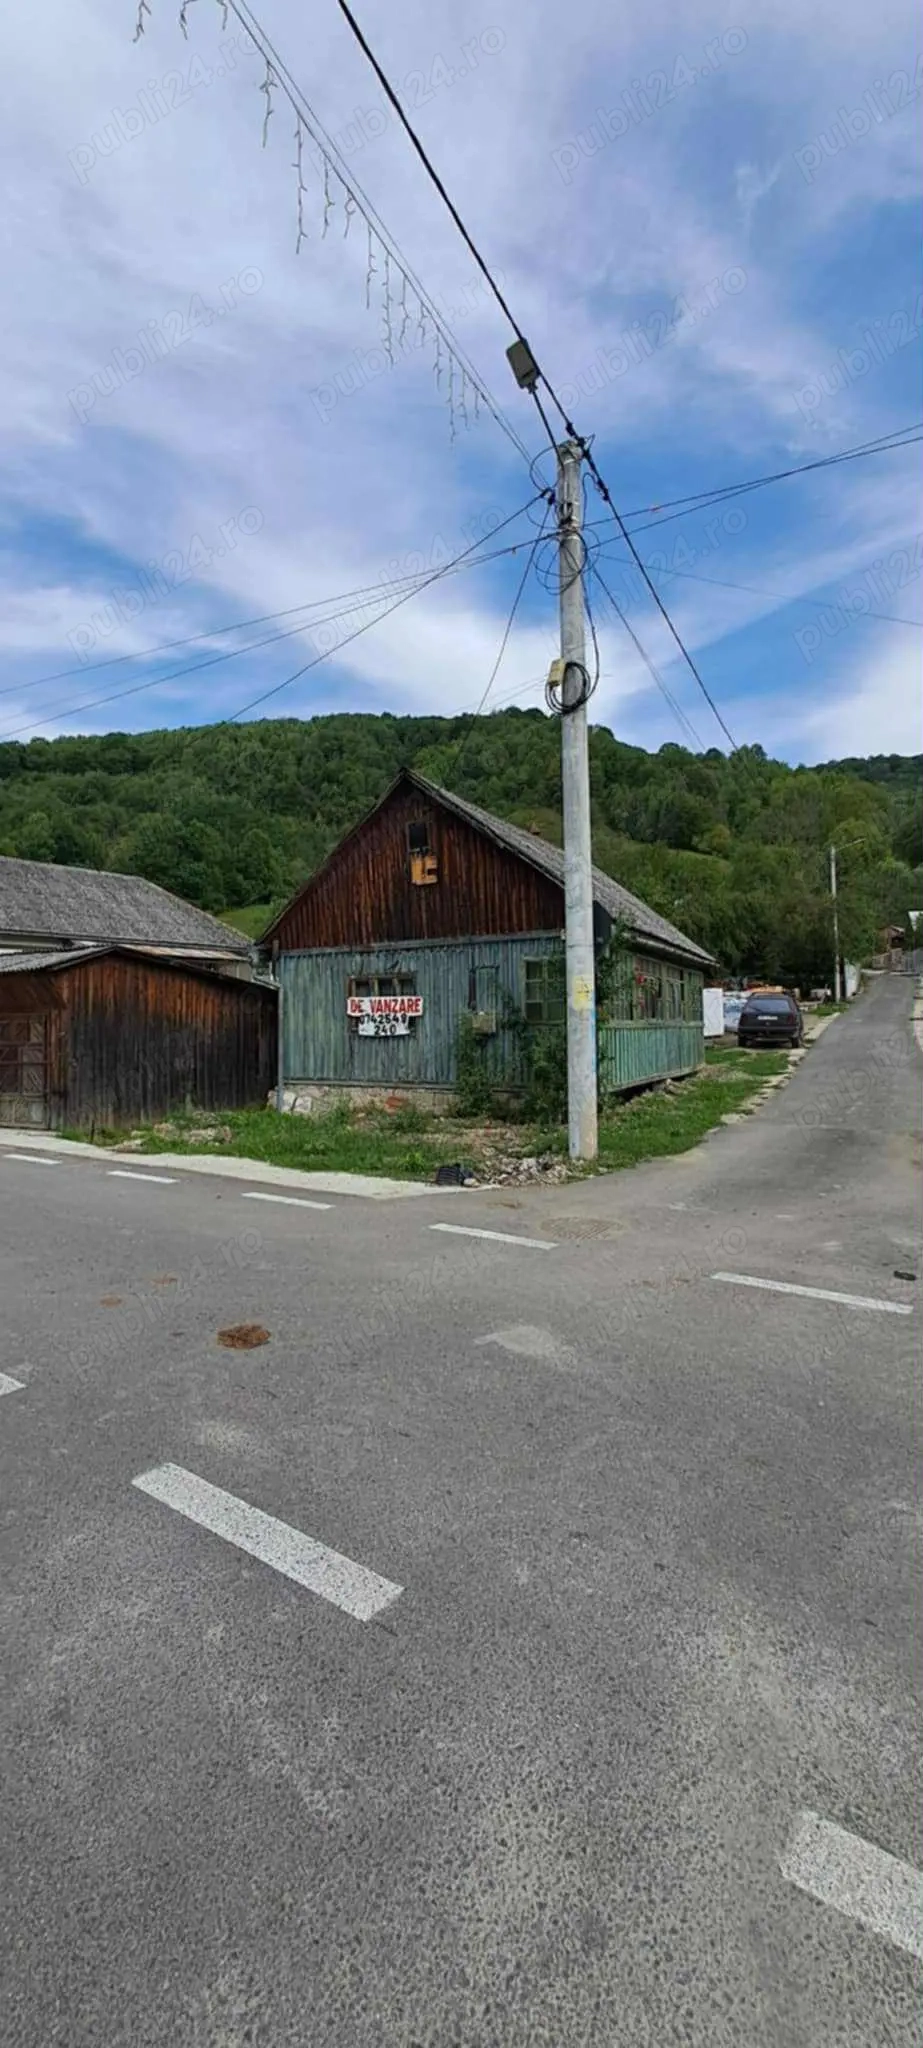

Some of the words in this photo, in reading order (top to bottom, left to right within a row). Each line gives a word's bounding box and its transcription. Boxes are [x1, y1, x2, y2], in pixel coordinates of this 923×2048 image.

[350, 999, 365, 1013] DE
[369, 998, 421, 1013] VANZARE
[374, 1024, 397, 1036] 240
